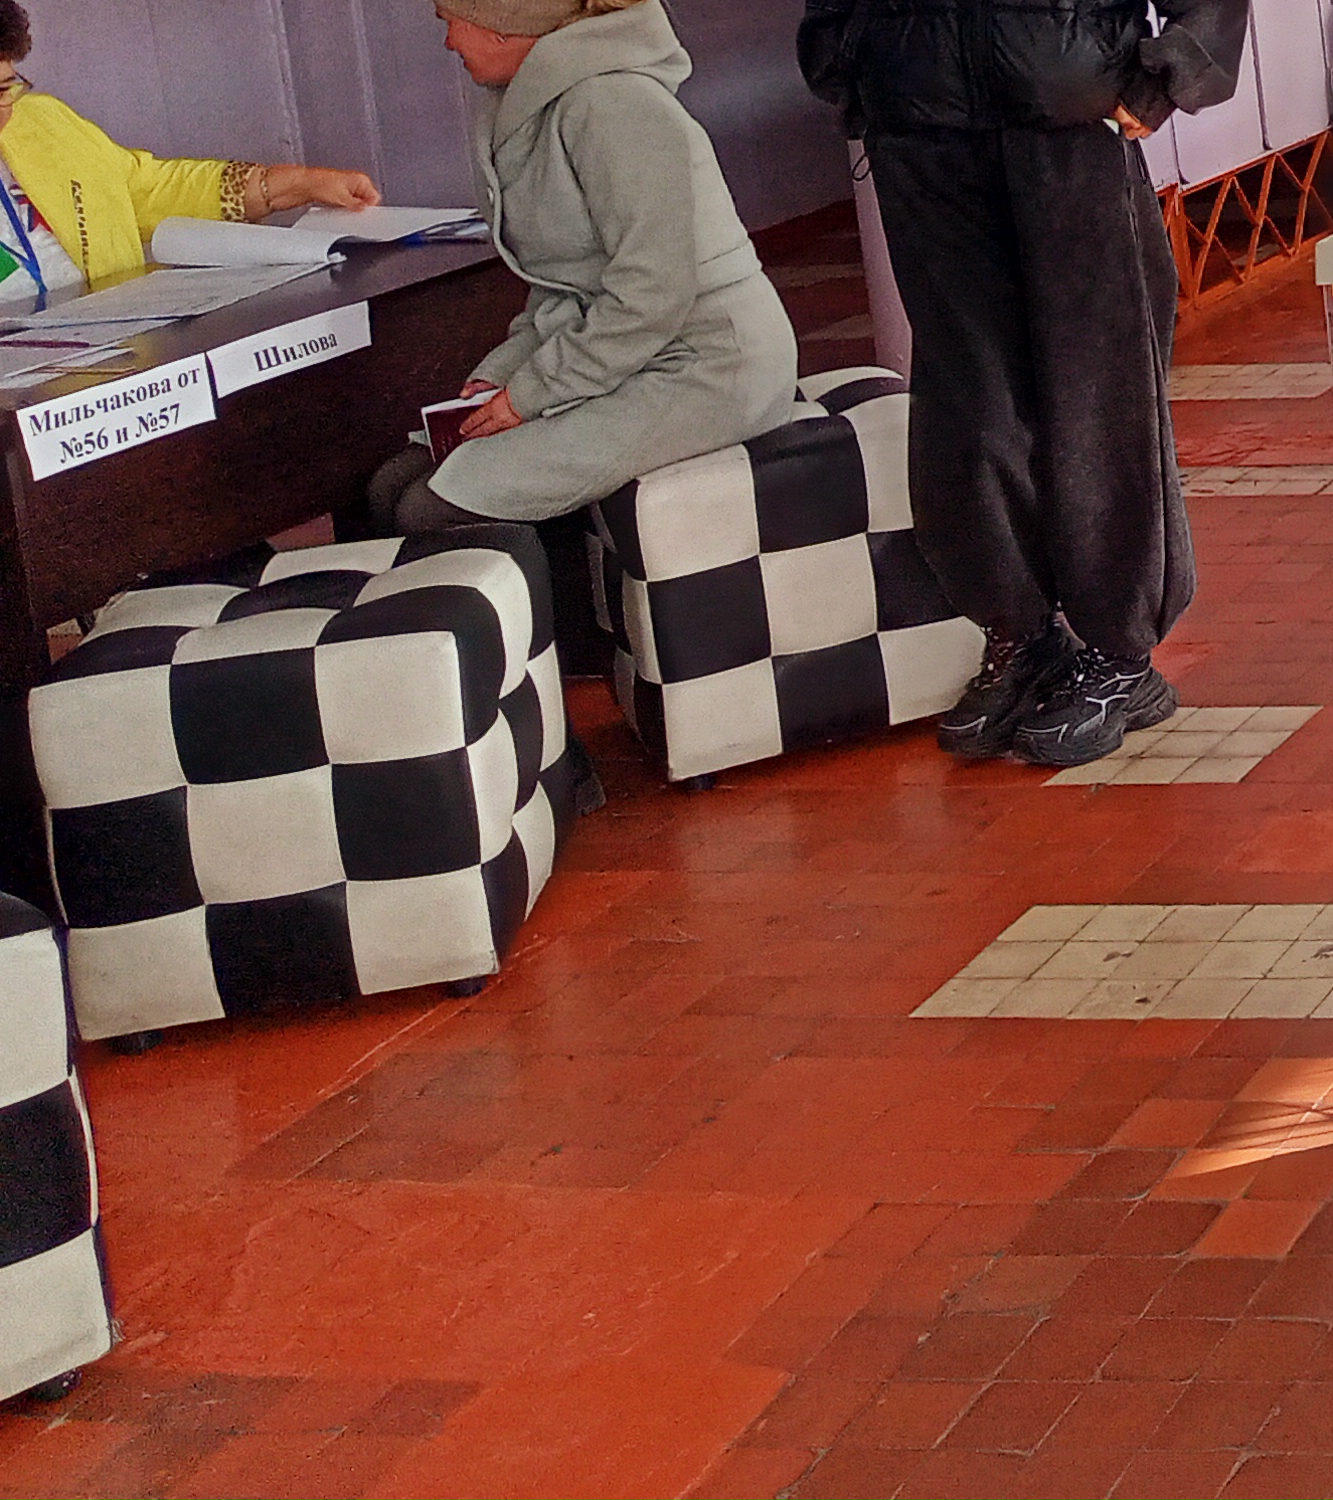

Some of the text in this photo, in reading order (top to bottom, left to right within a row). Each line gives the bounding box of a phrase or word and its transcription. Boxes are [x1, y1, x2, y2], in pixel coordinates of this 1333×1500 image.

[253, 332, 338, 372] Шилова
[28, 366, 201, 437] Мильчакова от
[59, 402, 181, 464] №56 и №57
